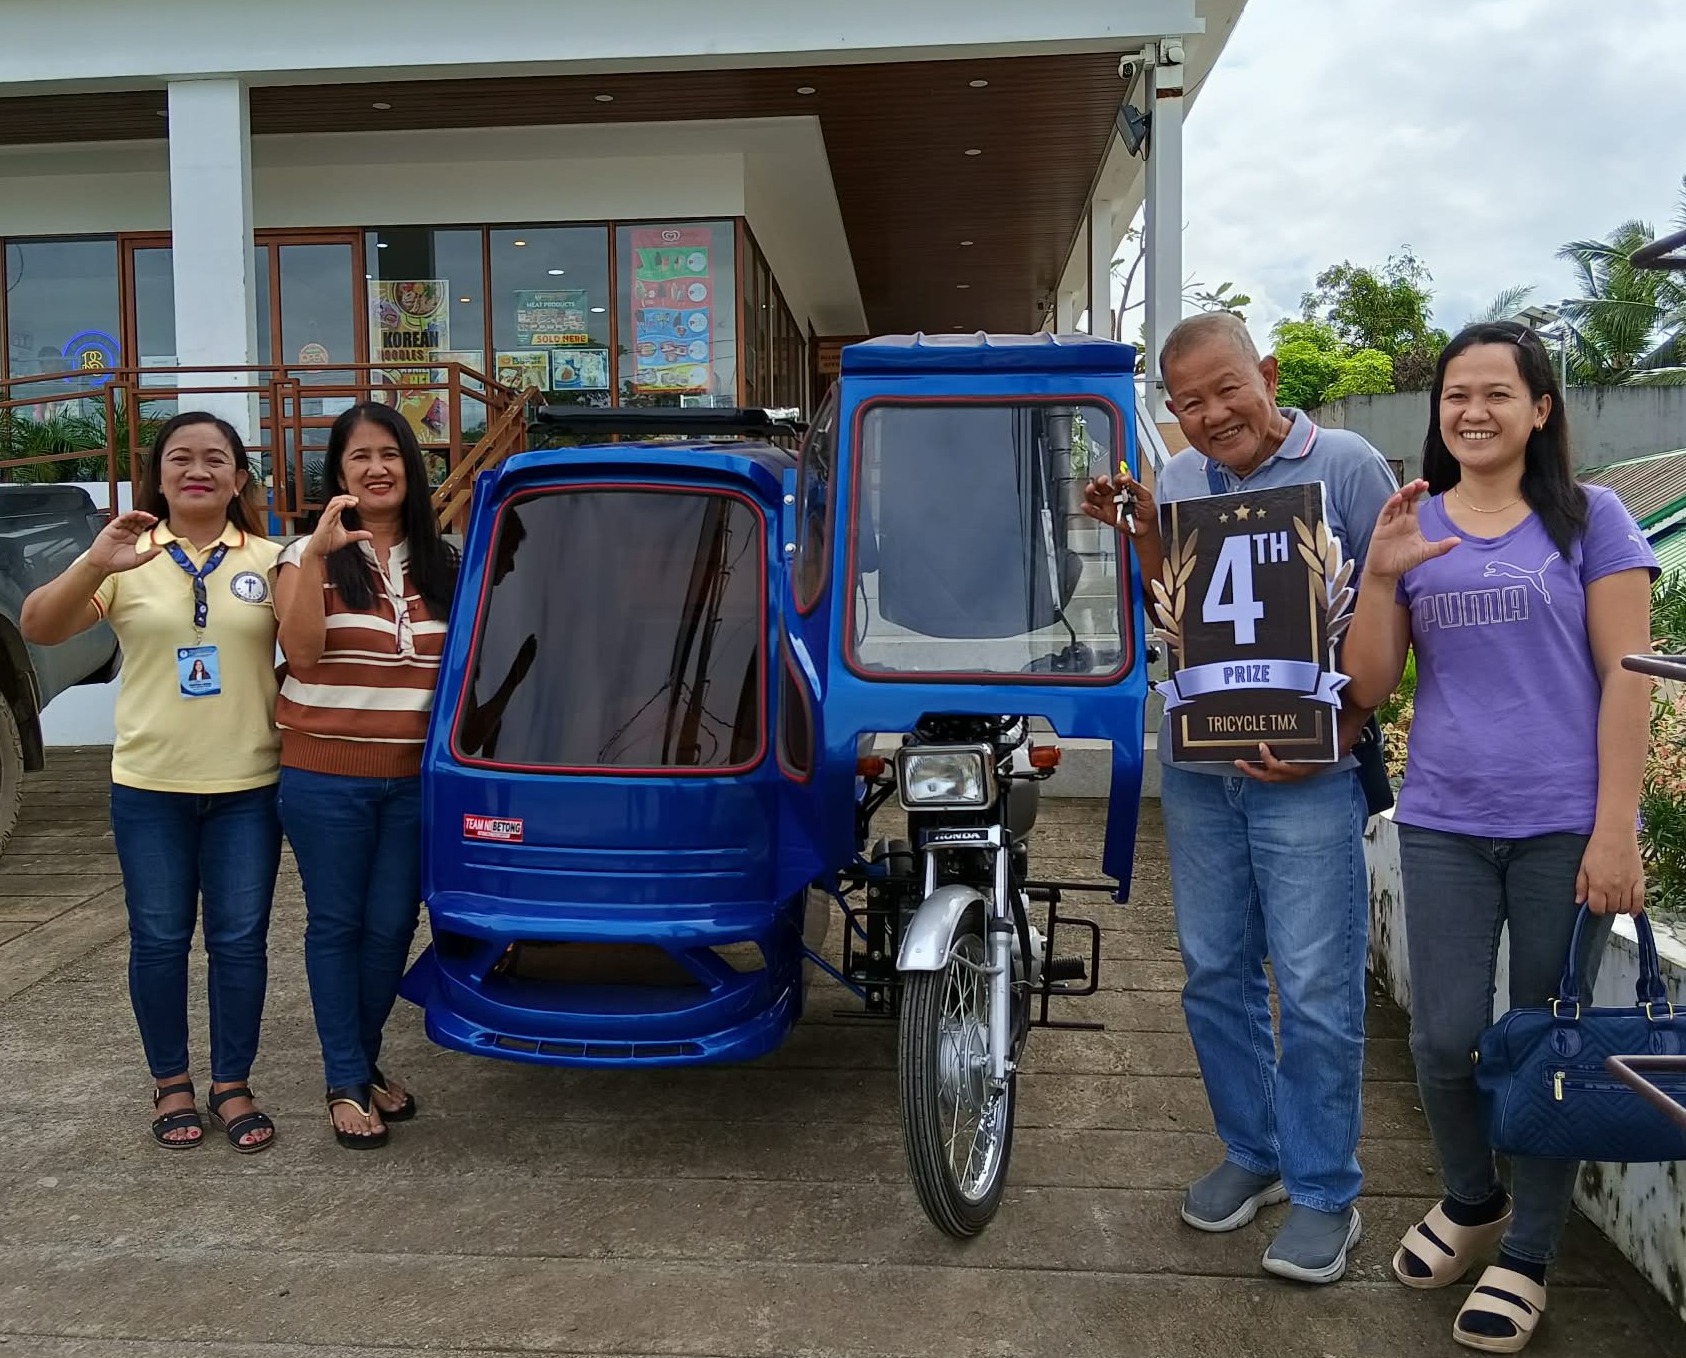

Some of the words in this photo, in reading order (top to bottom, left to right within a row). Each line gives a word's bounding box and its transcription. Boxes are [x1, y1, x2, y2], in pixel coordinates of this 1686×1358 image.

[383, 331, 439, 348] KOREAN
[536, 335, 560, 343] SOLD
[562, 334, 586, 343] HERE
[1202, 531, 1289, 645] 4TH
[1419, 584, 1529, 632] PUMA
[1223, 664, 1270, 684] PRIZE
[1206, 715, 1268, 733] TRICYCLE
[1269, 713, 1298, 731] TMX
[465, 818, 484, 831] TEAM
[492, 821, 521, 833] BETONG
